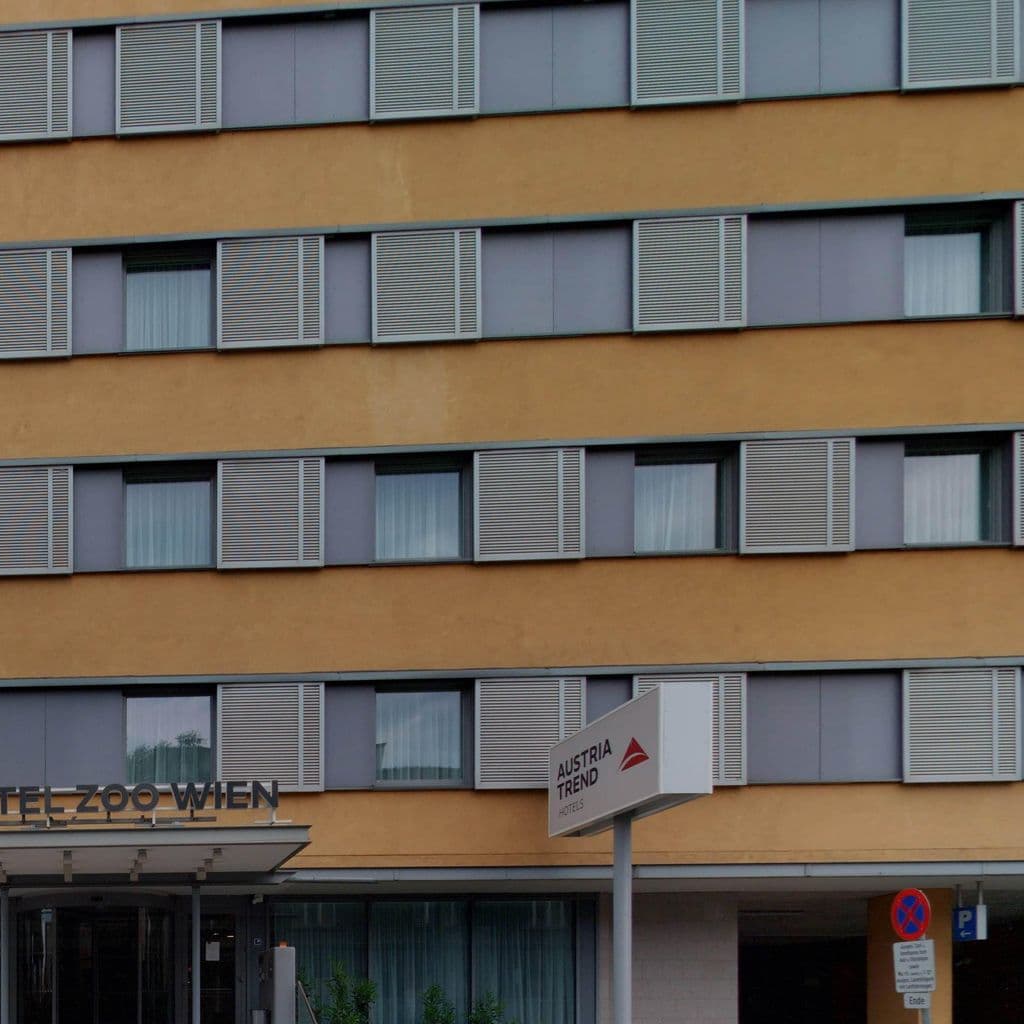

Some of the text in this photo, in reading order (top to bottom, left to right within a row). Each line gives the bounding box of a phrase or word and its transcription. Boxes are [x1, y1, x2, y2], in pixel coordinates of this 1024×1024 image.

[557, 738, 613, 781] AUSTRIA
[76, 783, 160, 813] ZOO
[170, 780, 279, 811] WIEN
[557, 767, 599, 800] TREND
[558, 799, 585, 817] HOTELS
[958, 910, 973, 929] P
[908, 996, 926, 1005] Ende
